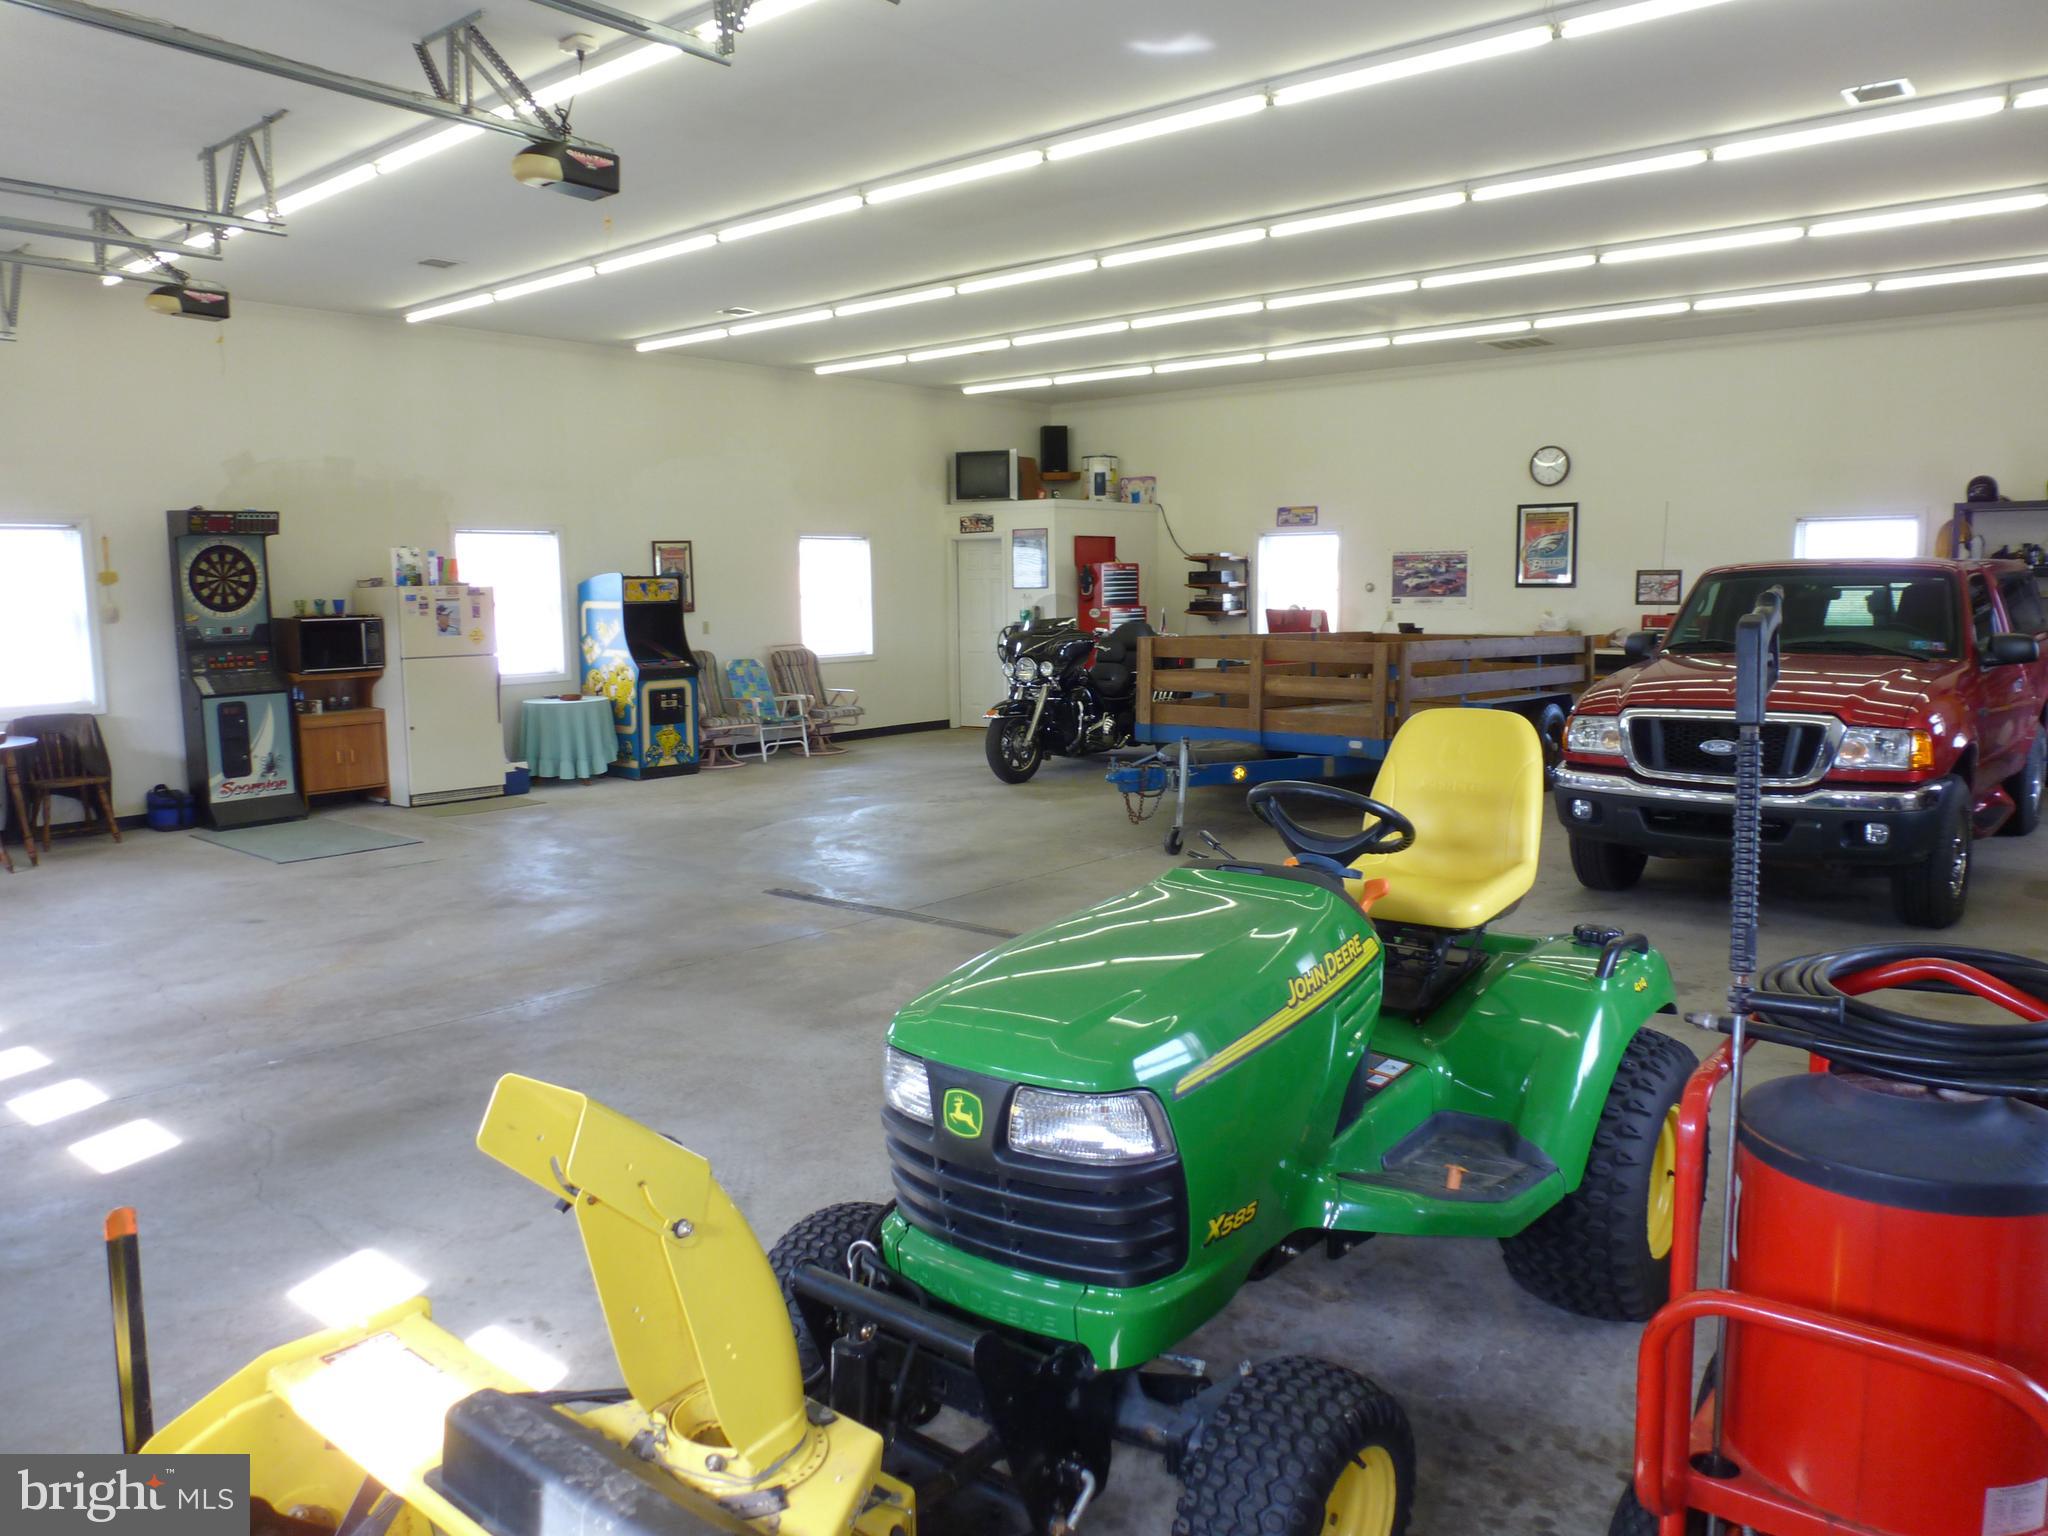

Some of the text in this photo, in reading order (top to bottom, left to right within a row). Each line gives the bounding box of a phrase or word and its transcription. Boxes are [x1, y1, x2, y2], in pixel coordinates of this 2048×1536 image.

[219, 779, 288, 798] Scorpion
[1286, 932, 1365, 1008] JOHN DEERE
[1203, 1199, 1258, 1247] X585
